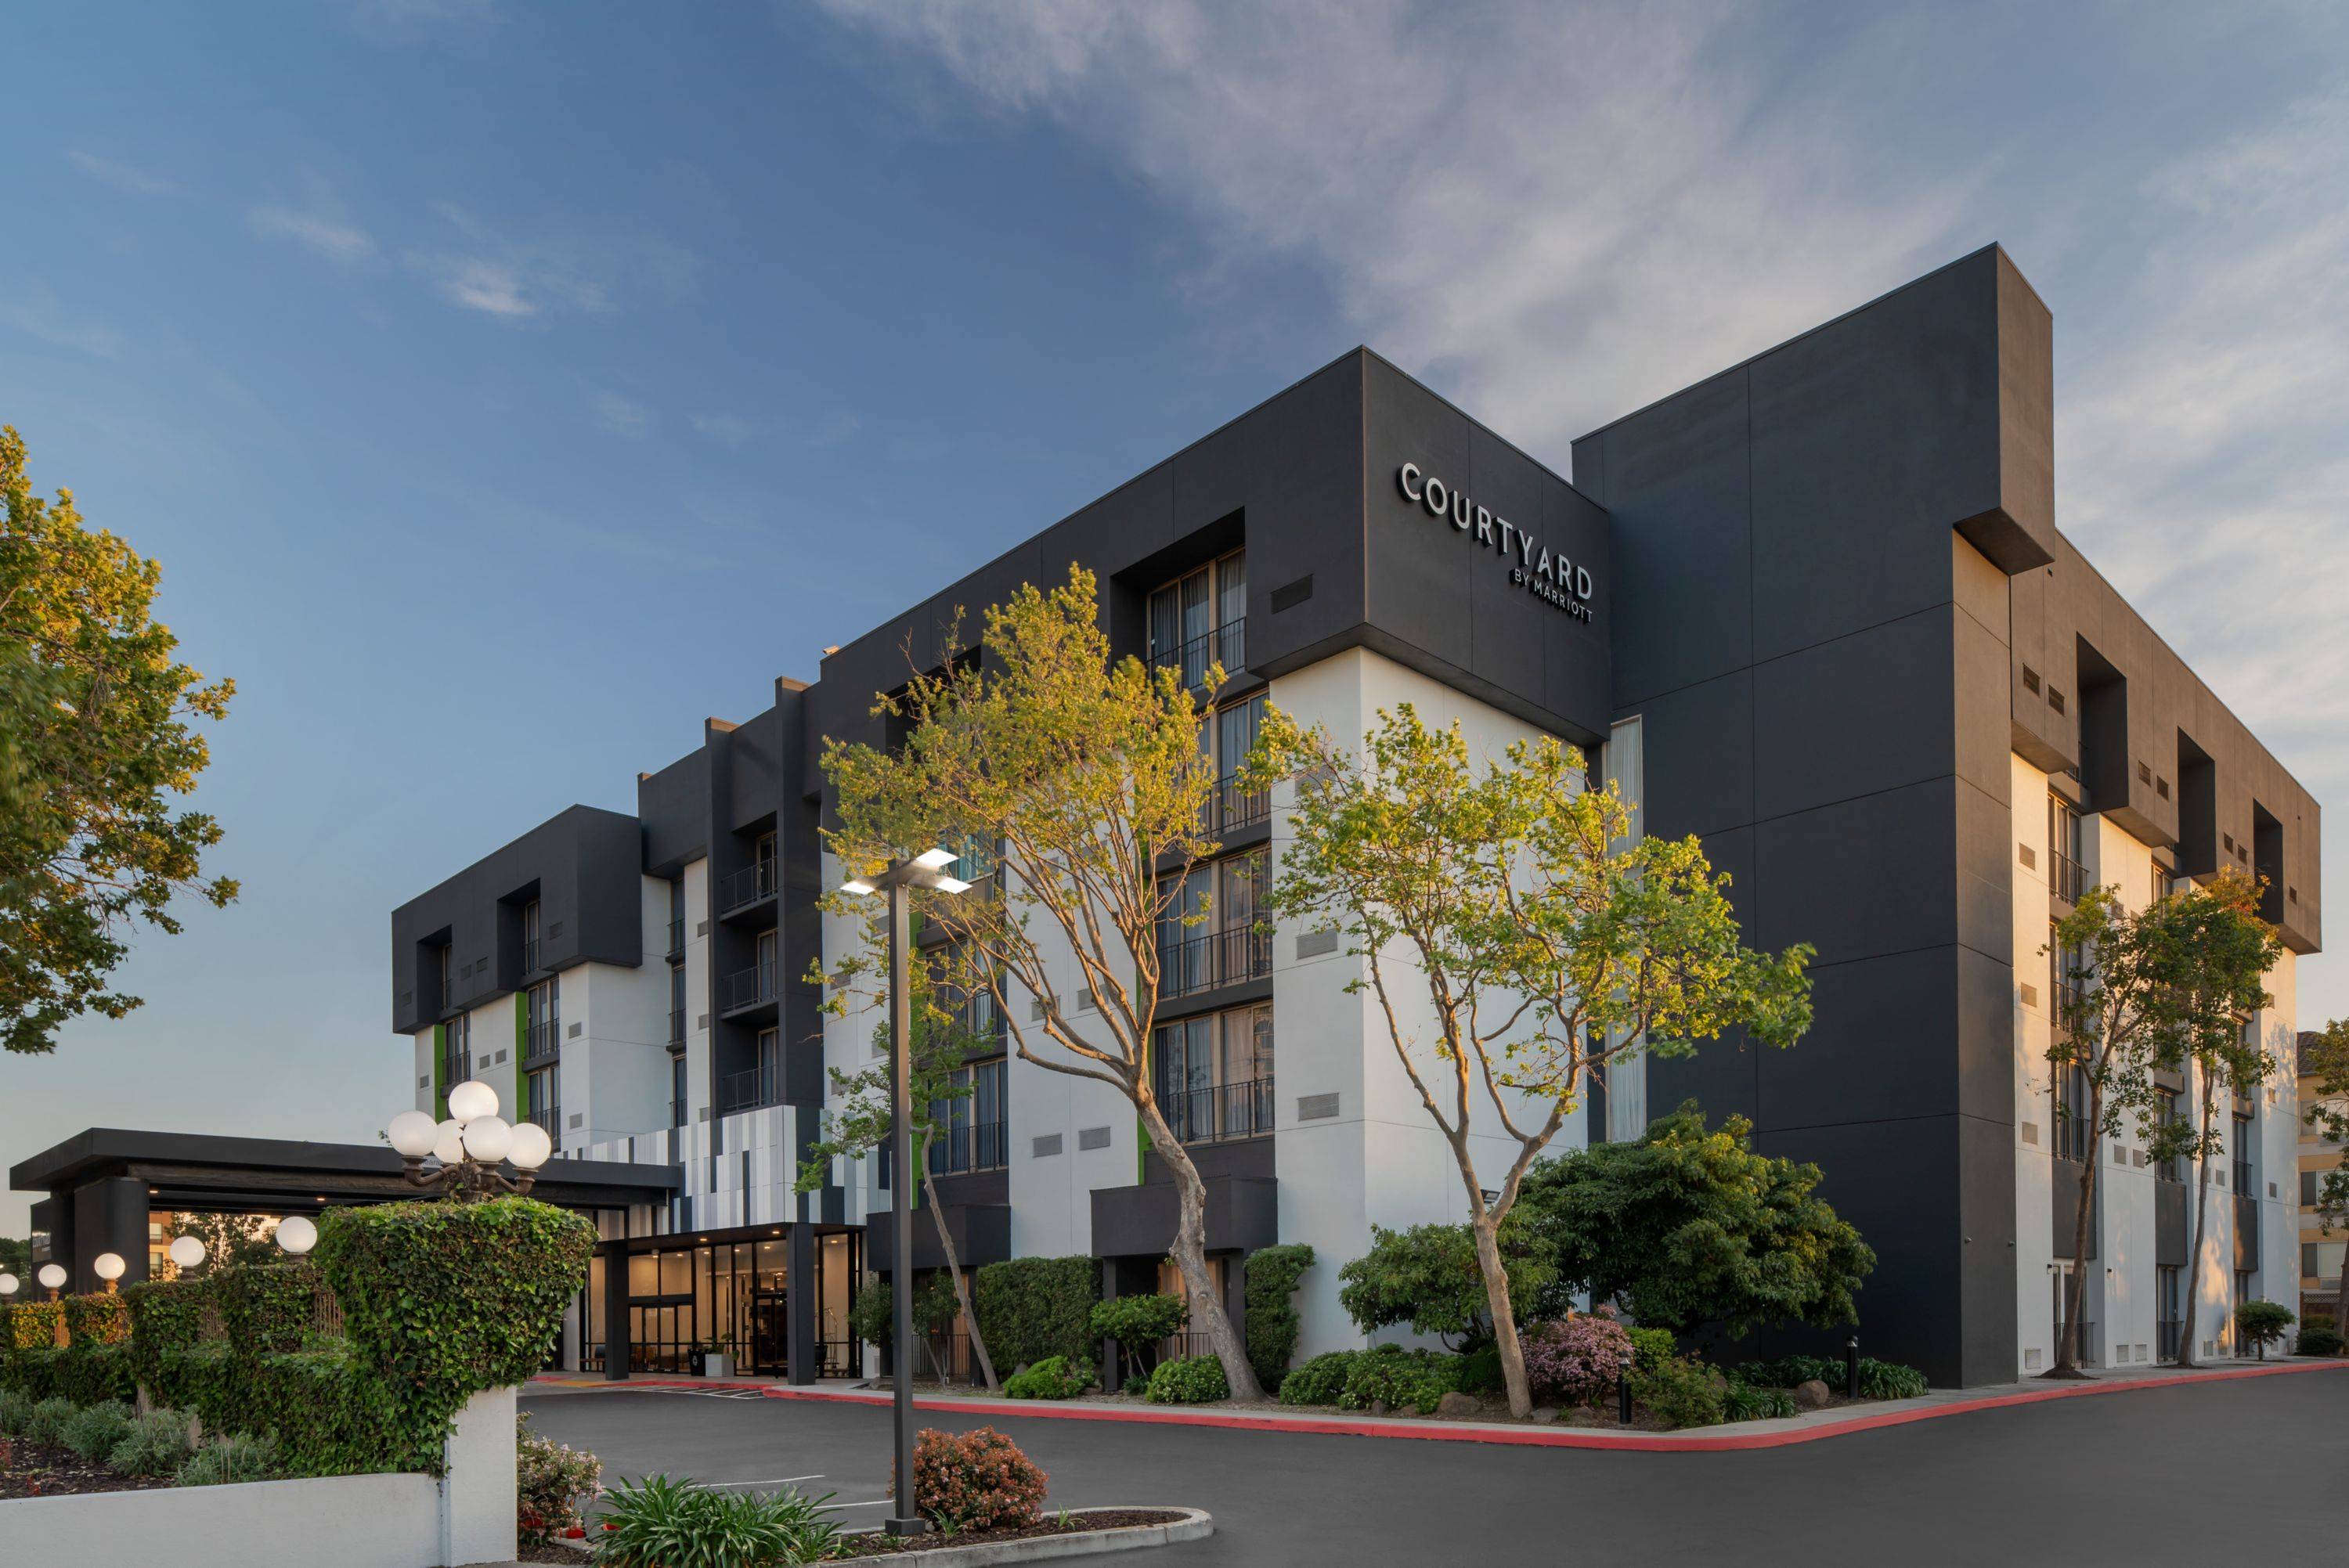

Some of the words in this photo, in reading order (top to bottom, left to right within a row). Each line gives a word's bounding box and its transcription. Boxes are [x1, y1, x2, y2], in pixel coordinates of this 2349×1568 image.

[1398, 463, 1593, 600] COURTYARD
[1513, 568, 1529, 586] BY
[1533, 579, 1593, 622] MARRIOTT
